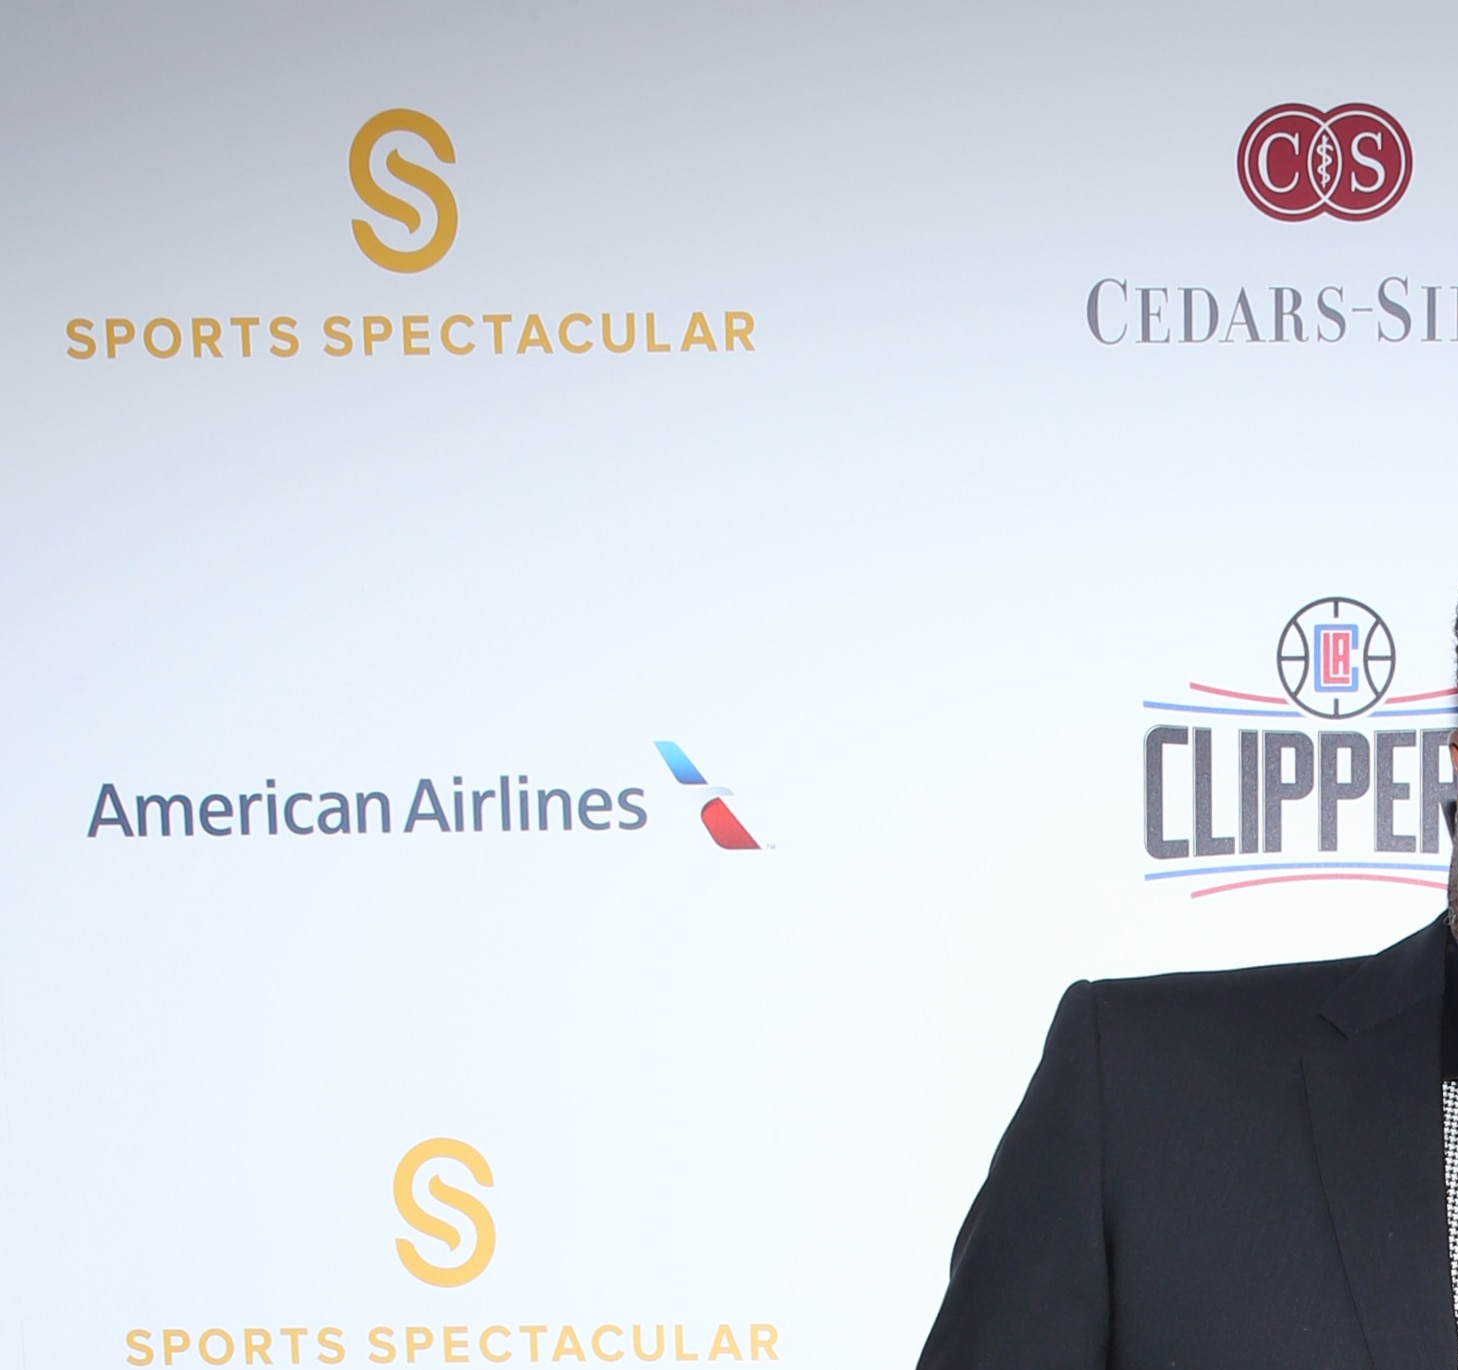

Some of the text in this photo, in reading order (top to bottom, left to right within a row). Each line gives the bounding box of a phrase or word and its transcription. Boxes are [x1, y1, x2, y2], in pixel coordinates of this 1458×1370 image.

[65, 310, 755, 360] SPORTS SPECTACULAR
[86, 774, 648, 838] American Airlines
[1143, 724, 1458, 860] CLIPPER
[125, 1323, 779, 1367] SPORTS SPECTACULAR
